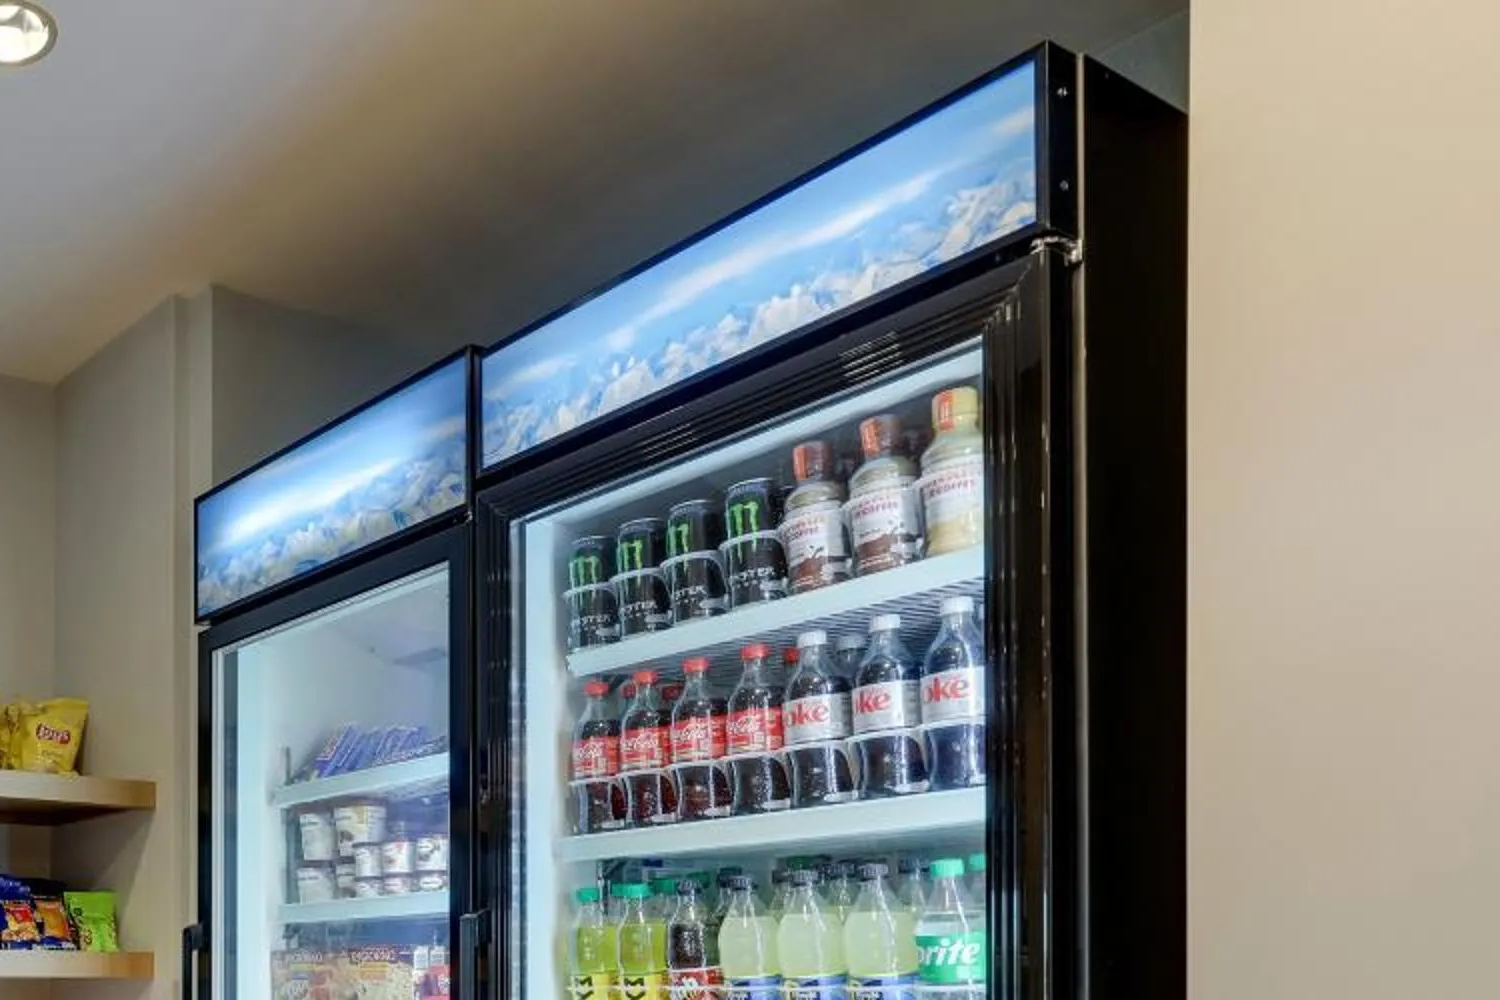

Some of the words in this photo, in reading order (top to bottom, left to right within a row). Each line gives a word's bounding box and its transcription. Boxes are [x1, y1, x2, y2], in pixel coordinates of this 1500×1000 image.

[856, 690, 891, 714] ke
[923, 677, 968, 704] oke
[785, 702, 828, 727] oke
